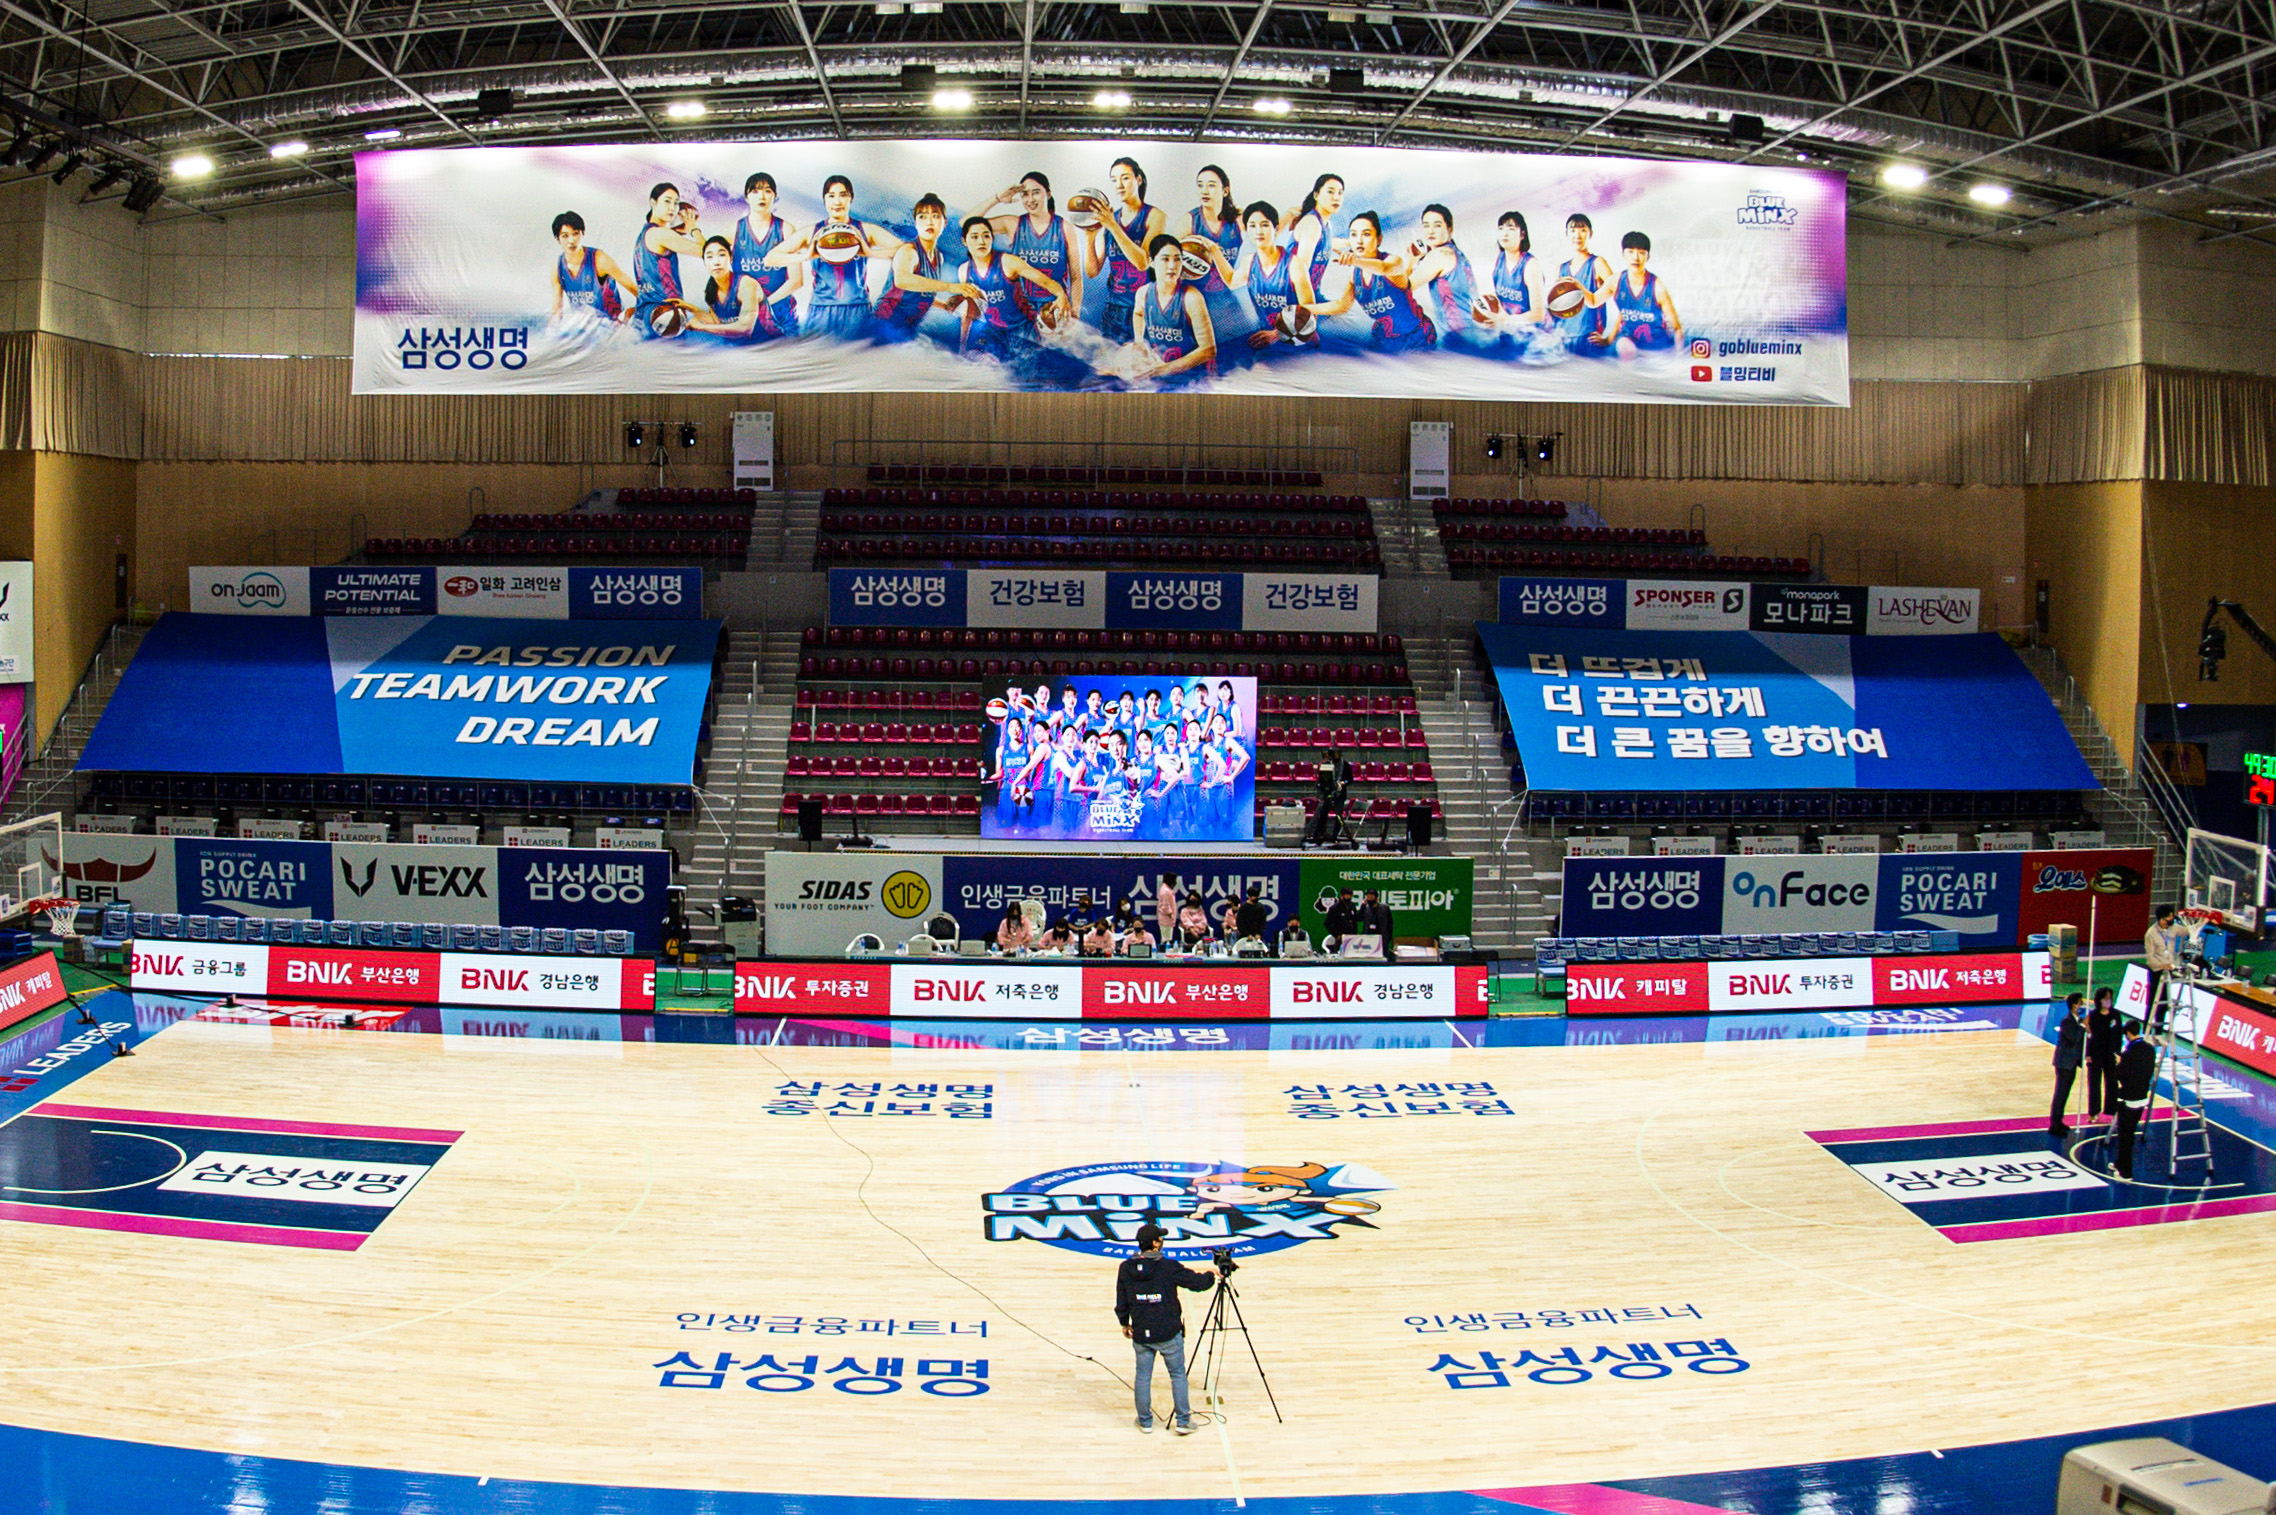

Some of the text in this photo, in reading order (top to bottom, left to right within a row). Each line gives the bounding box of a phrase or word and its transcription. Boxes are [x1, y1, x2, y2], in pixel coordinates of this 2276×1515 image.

[1747, 195, 1785, 208] BLUE
[397, 326, 529, 371] 삼성생명
[1718, 339, 1802, 357] goblueminx
[1719, 366, 1776, 382] 블밍티비
[337, 574, 421, 586] ULTIMATE
[479, 576, 562, 592] 일화 고려인삼
[590, 575, 683, 605] 삼성생명
[325, 590, 421, 601] POTENTIAL
[851, 576, 946, 607] 삼성생명
[990, 579, 1085, 606] 건강보험
[1127, 579, 1222, 611] 삼성생명
[1265, 583, 1359, 611] 건강보험
[1519, 584, 1607, 616] 삼성생명
[1634, 589, 1715, 607] SPONSER
[1785, 590, 1840, 602] monapark
[1763, 602, 1853, 624] 모나파크
[1878, 598, 1972, 624] LASHEVAN
[442, 644, 676, 668] PASSION
[1528, 653, 1708, 682] 더 뜨겁게
[350, 673, 668, 705] TEAMWORK
[1542, 684, 1766, 718] 더 끈끈하게
[455, 716, 660, 746] DREAM
[1557, 725, 1889, 759] 더 큰 꿈을 향하여
[170, 828, 210, 837] LEADERS
[340, 833, 382, 843] LEADERS
[429, 836, 472, 845] LEADERS
[519, 838, 564, 847] LEADERS
[612, 840, 657, 849] LEADERS
[1583, 847, 1625, 856] LEADERS
[1670, 846, 1711, 856] LEADERS
[1755, 846, 1796, 855] LEADERS
[1836, 845, 1875, 854] LEADERS
[1916, 844, 1954, 853] LEADERS
[1992, 843, 2029, 852] LEADERS
[200, 858, 307, 882] POCARI
[201, 880, 297, 901] SWEAT
[391, 864, 488, 898] VEXX
[524, 862, 645, 904] 삼성생명
[798, 880, 873, 901] SIDAS
[1587, 870, 1700, 910] 삼성생명
[1901, 872, 1997, 893] POCARI
[75, 885, 132, 904] BFL
[961, 883, 1111, 911] 인생금융파트너
[1900, 892, 1987, 912] SWEAT
[800, 903, 825, 911] FOOT
[192, 959, 247, 977] 금융그룹
[287, 960, 420, 986] BNK 부산은행
[461, 967, 599, 992] BNK 경남은행
[804, 977, 869, 998] 투자증권
[1636, 978, 1687, 996] 캐피탈
[1729, 973, 1854, 996] BNK 투자증권
[1889, 968, 2007, 992] BNK 저축은행
[914, 979, 1059, 1003] BNK 저축은행
[1103, 980, 1248, 1004] BNK 부산은행
[1292, 981, 1433, 1004] BNK 경남은행
[1015, 1027, 1230, 1044] 삼성생명
[2217, 1014, 2262, 1051] BNK
[13, 1021, 132, 1076] LEADERS
[773, 1081, 993, 1099] 삼성생명
[1283, 1081, 1498, 1100] 삼성생명
[761, 1099, 992, 1119] 종신보험
[1287, 1099, 1516, 1119] 종신보험
[191, 1162, 408, 1195] 삼성생명
[1077, 1163, 1148, 1175] SAMSUNG
[1884, 1158, 2079, 1191] 삼성생명
[985, 1193, 1200, 1213] BLUE
[676, 1312, 988, 1339] 인생금융파트너
[1403, 1303, 1703, 1334] 인생금융파트너
[652, 1351, 991, 1398] 삼성생명
[1426, 1338, 1751, 1390] 삼성생명
